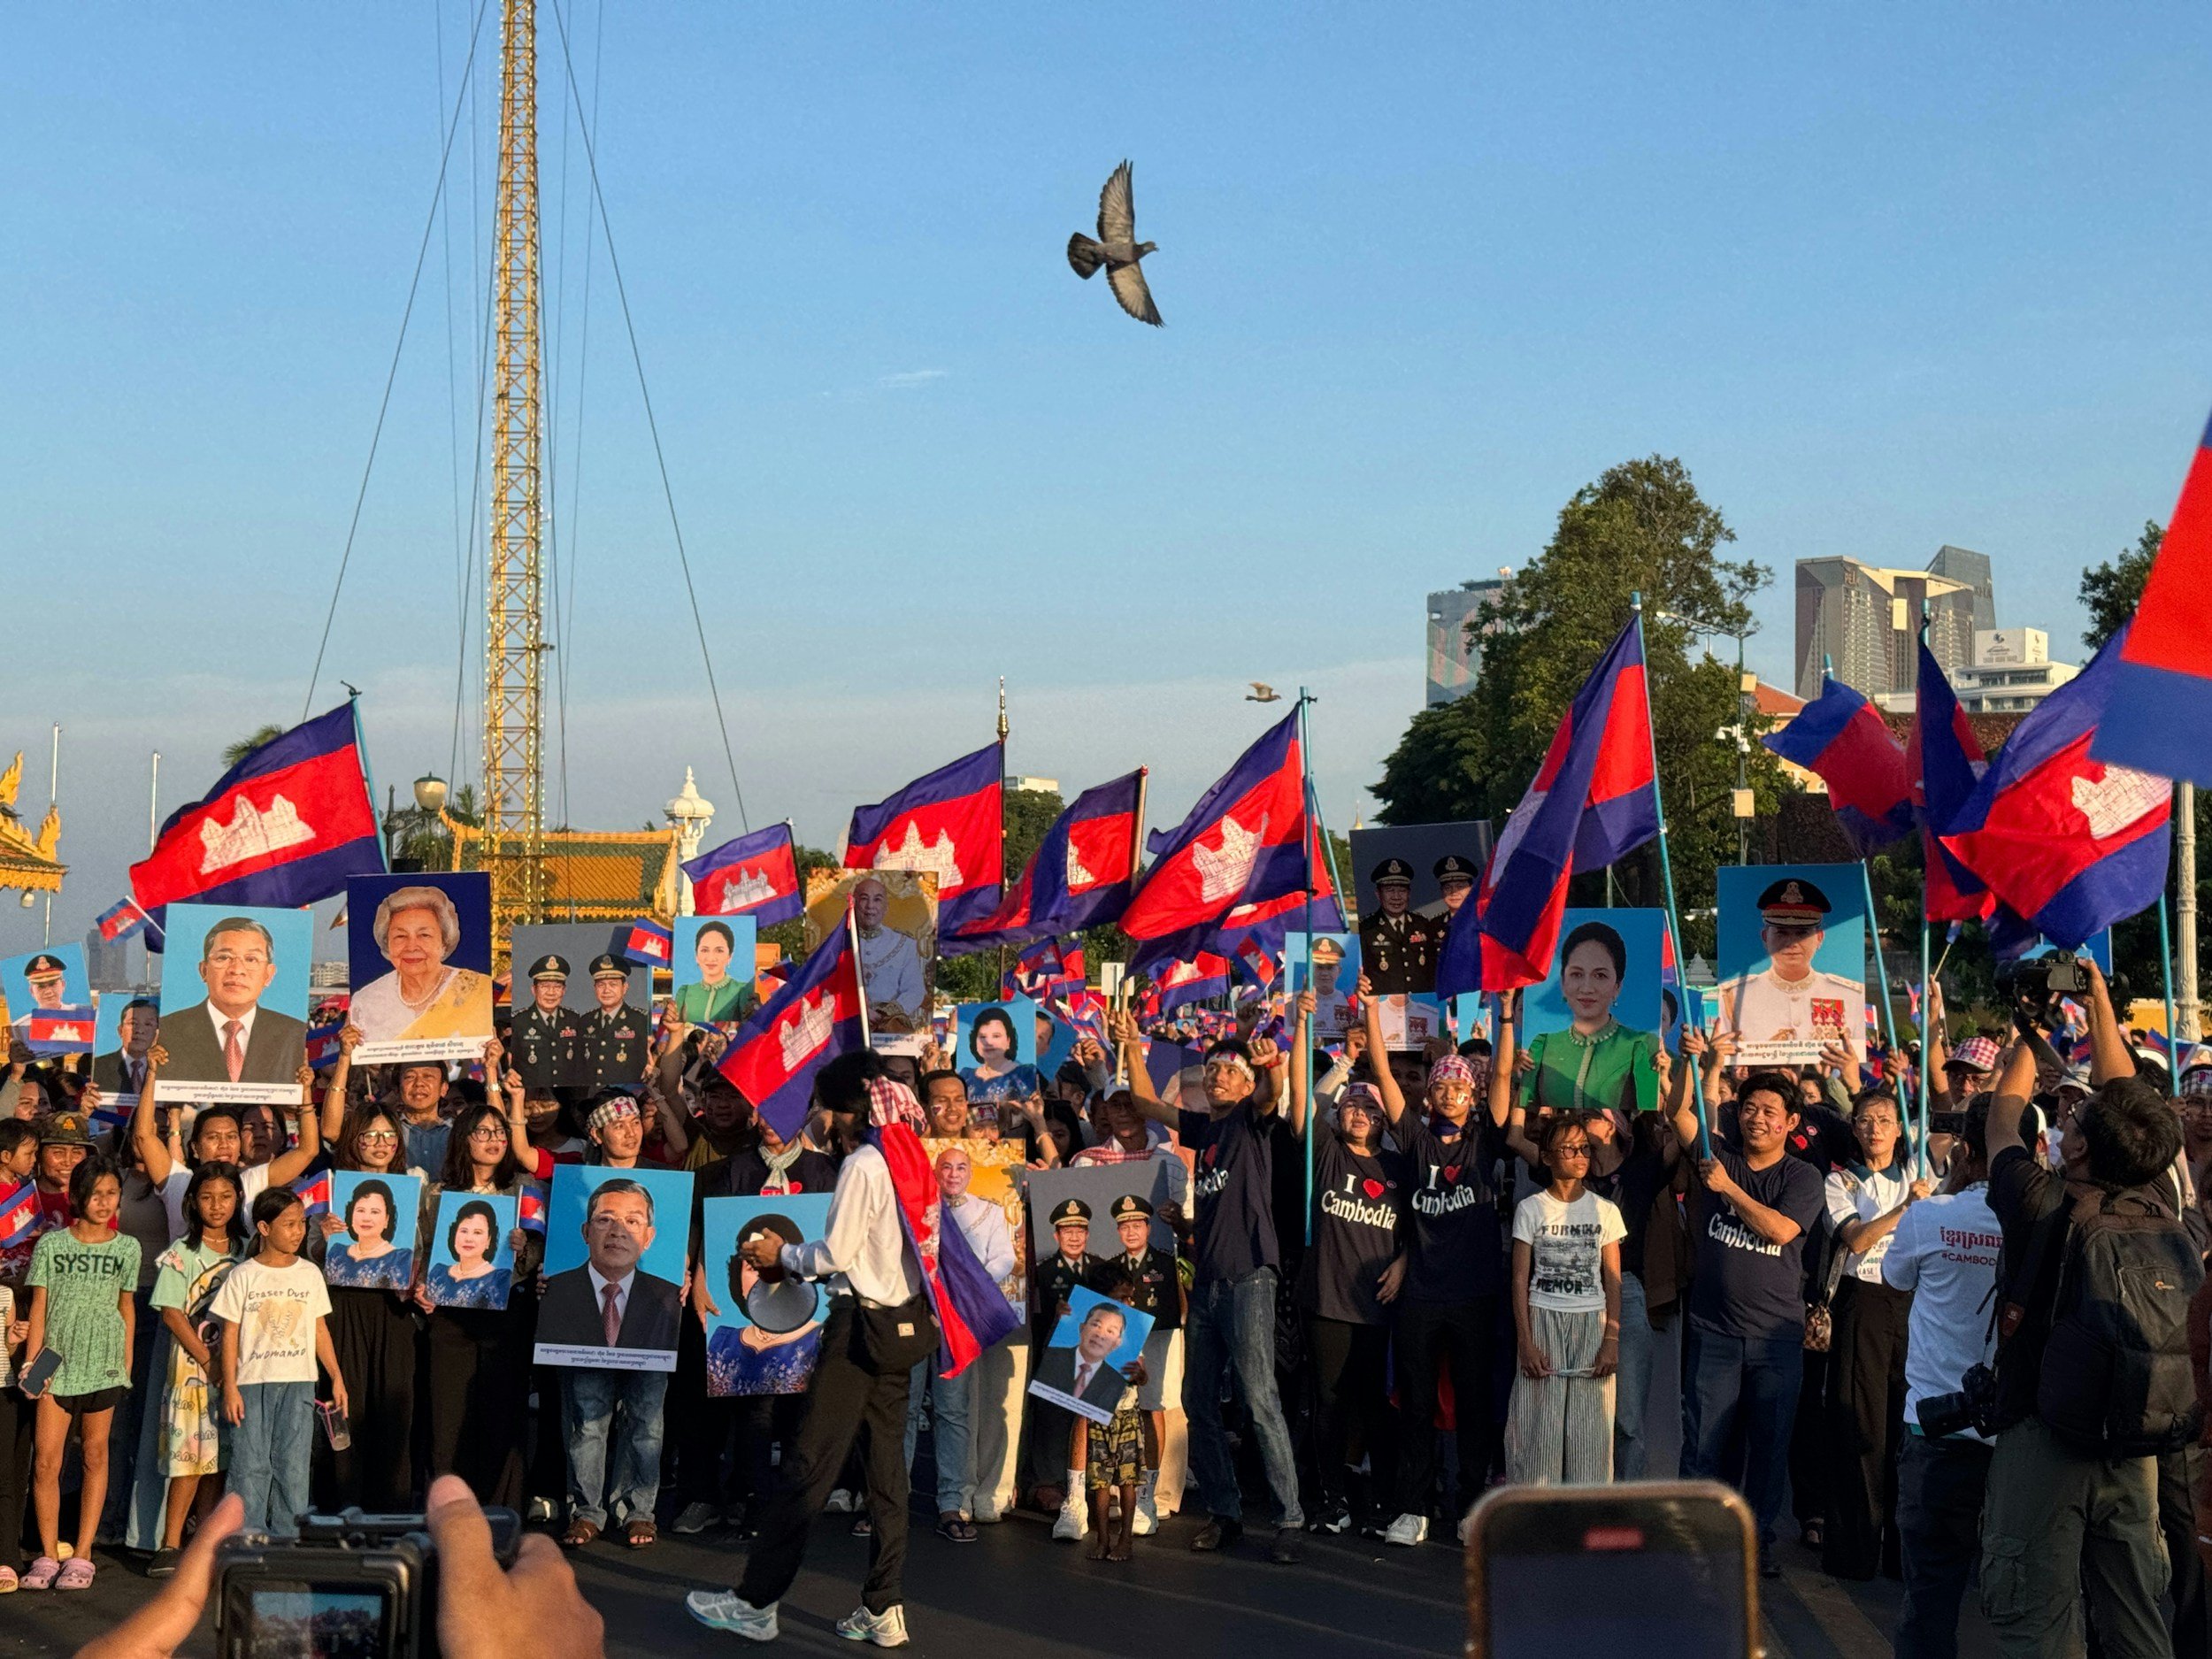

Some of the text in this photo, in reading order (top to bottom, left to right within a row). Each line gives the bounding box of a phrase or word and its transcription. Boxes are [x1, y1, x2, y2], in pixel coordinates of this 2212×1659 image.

[1343, 1173, 1357, 1194] I
[1426, 1164, 1440, 1190] I
[1321, 1189, 1397, 1231] Cambodia
[54, 1253, 125, 1275] SYSTEM
[248, 1287, 311, 1300] Eraser Dust
